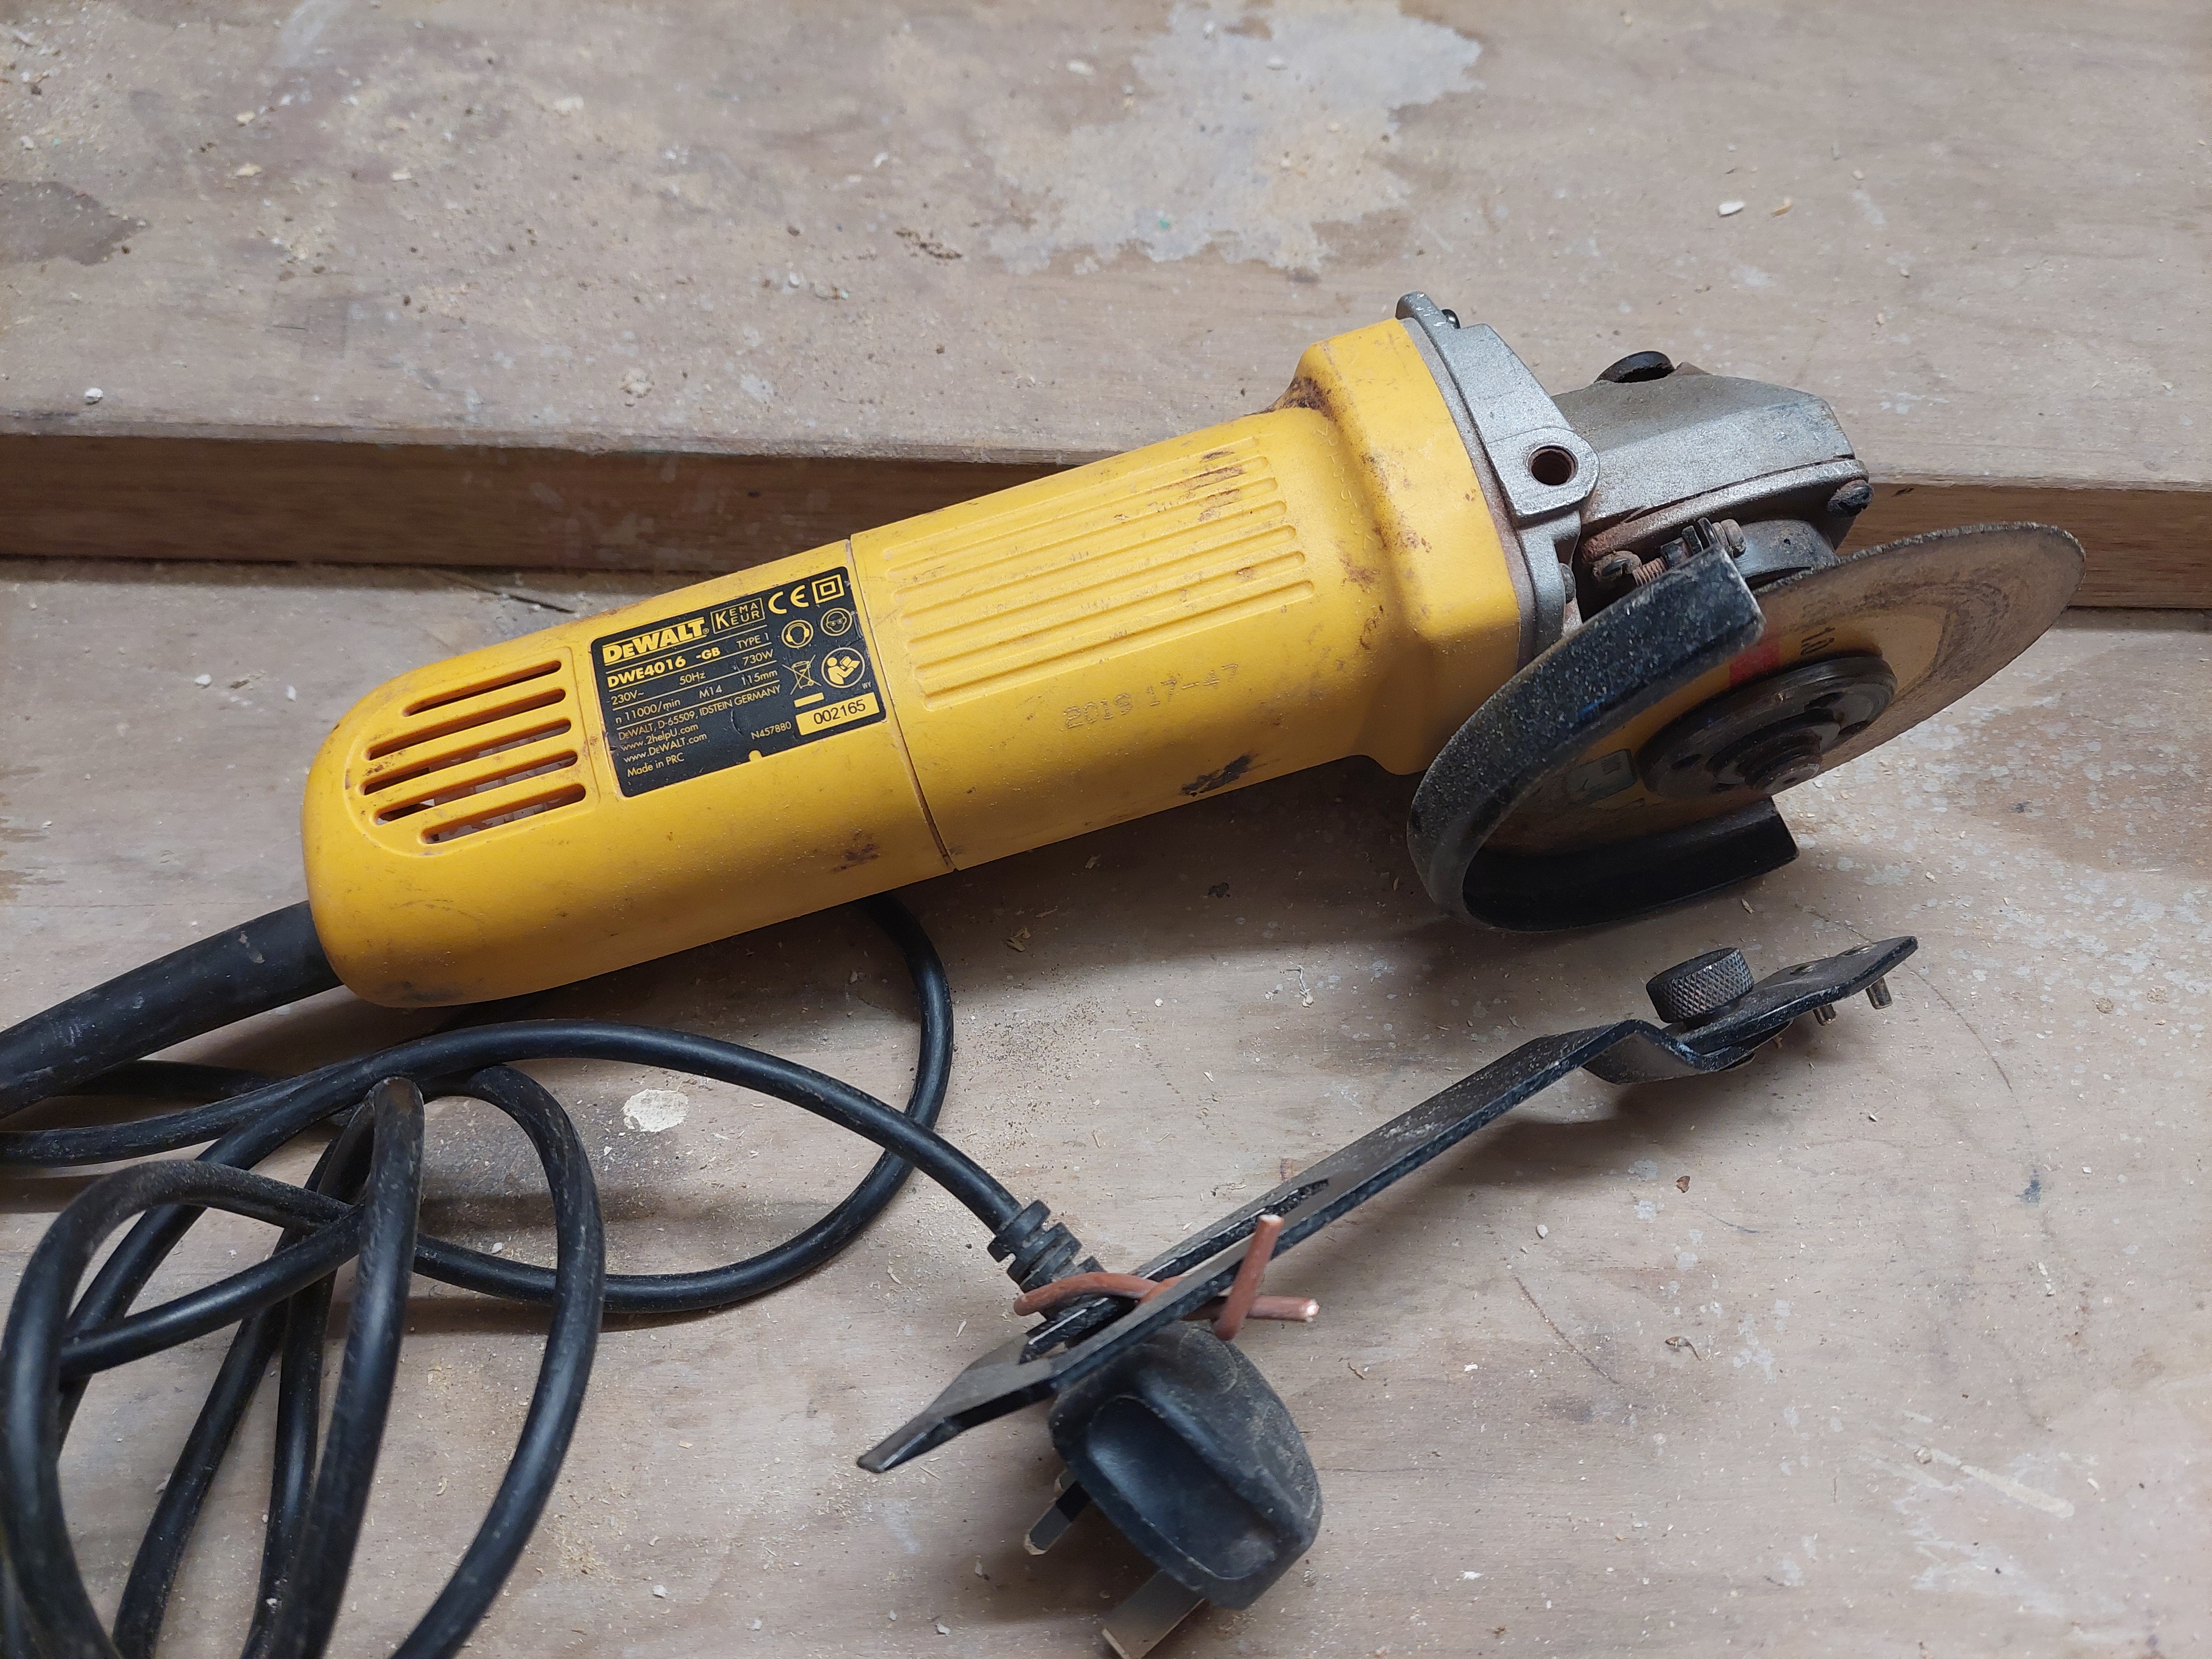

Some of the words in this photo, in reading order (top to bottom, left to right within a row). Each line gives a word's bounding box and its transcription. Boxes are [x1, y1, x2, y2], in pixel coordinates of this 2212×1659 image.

[607, 657, 686, 688] DWE4016
[736, 634, 762, 649] TYPE
[765, 632, 769, 641] 1
[679, 671, 706, 686] 50Hz
[742, 649, 774, 666] 730W
[615, 717, 622, 725] n
[624, 698, 681, 722] 11000/min
[699, 685, 723, 699] M14
[741, 670, 778, 686] 115mm
[862, 681, 872, 690] WY
[657, 710, 698, 728] D-65509,
[699, 698, 733, 717] IDSTEIN
[734, 685, 781, 706] GERMANY
[813, 699, 866, 725] 002165
[1062, 692, 1133, 729] 2019
[620, 723, 699, 751] www.2helpU.com
[751, 721, 792, 740] N457880
[627, 763, 653, 777] Made
[655, 760, 664, 769] in
[666, 752, 685, 765] PRC
